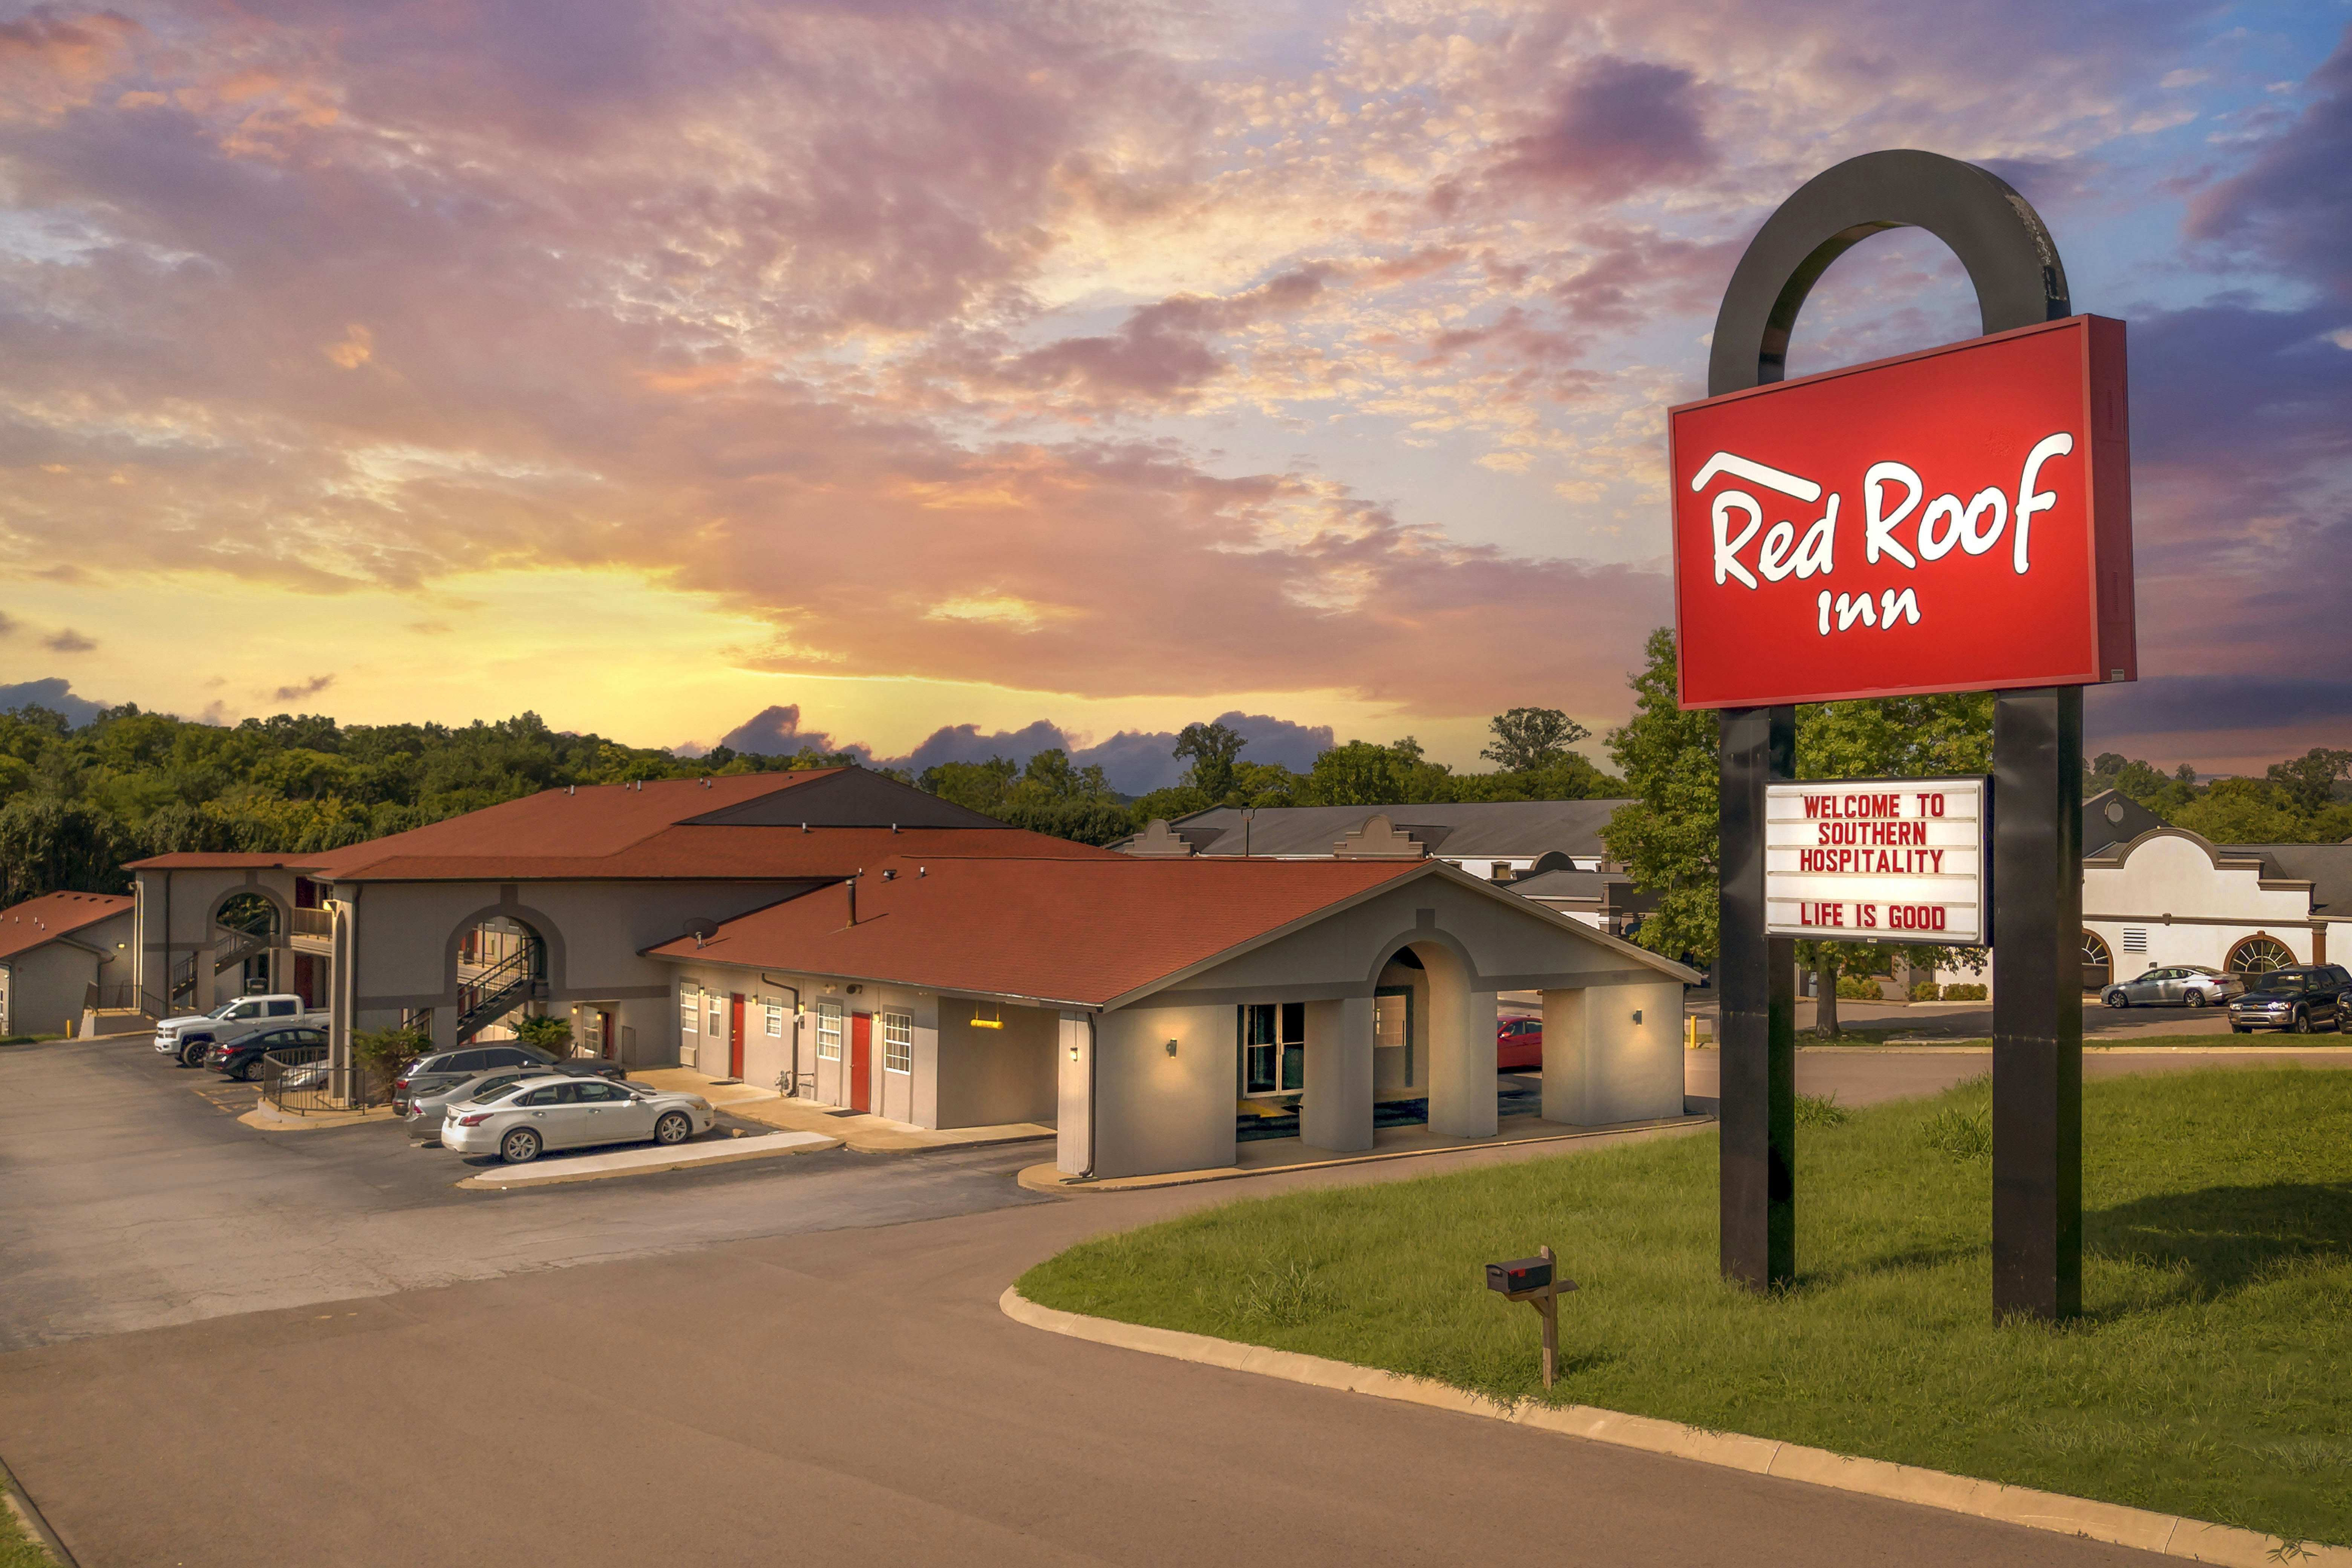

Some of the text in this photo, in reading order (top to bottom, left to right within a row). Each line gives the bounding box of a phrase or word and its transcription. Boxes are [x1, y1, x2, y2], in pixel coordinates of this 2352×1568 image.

[1710, 432, 2073, 590] Red Roof
[1804, 793, 1944, 818] WELCOME TO
[1818, 821, 1926, 846] SOUTHERN
[1800, 849, 1943, 874] HOSPITALITY
[1801, 902, 1945, 930] LIFE IS GOOD
